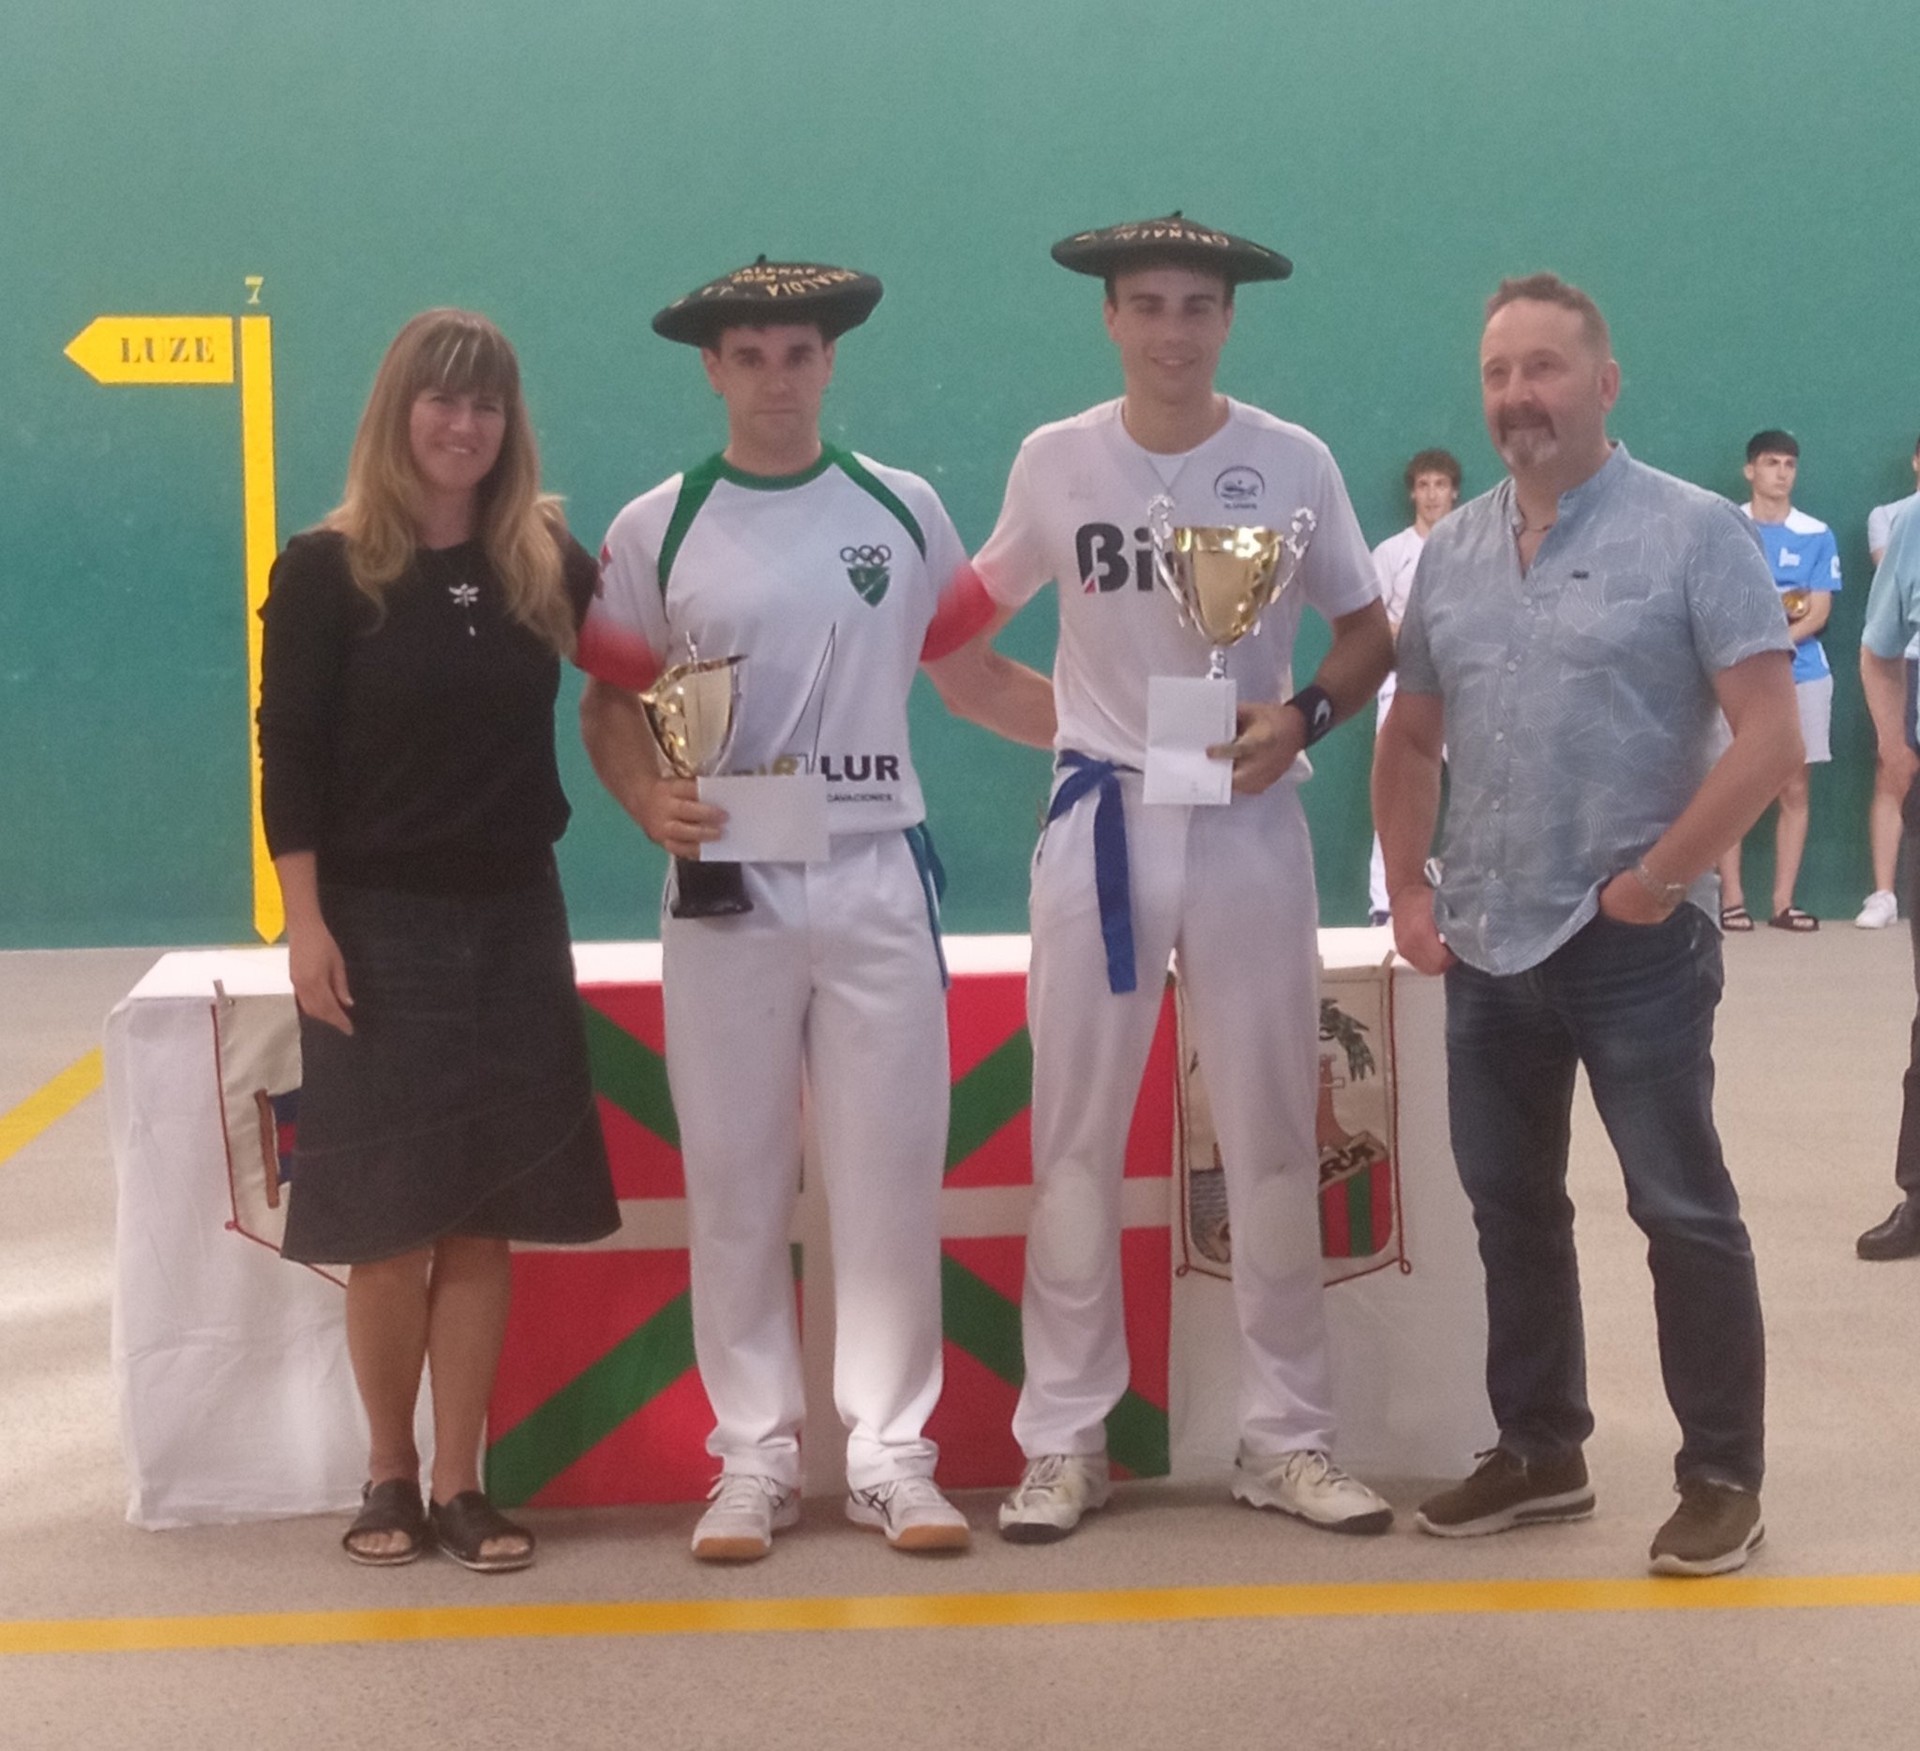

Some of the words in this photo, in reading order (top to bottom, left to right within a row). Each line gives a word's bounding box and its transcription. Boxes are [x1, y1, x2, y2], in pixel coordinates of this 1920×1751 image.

[244, 276, 264, 304] 7
[120, 336, 215, 364] LUZE
[820, 754, 900, 782] LUR
